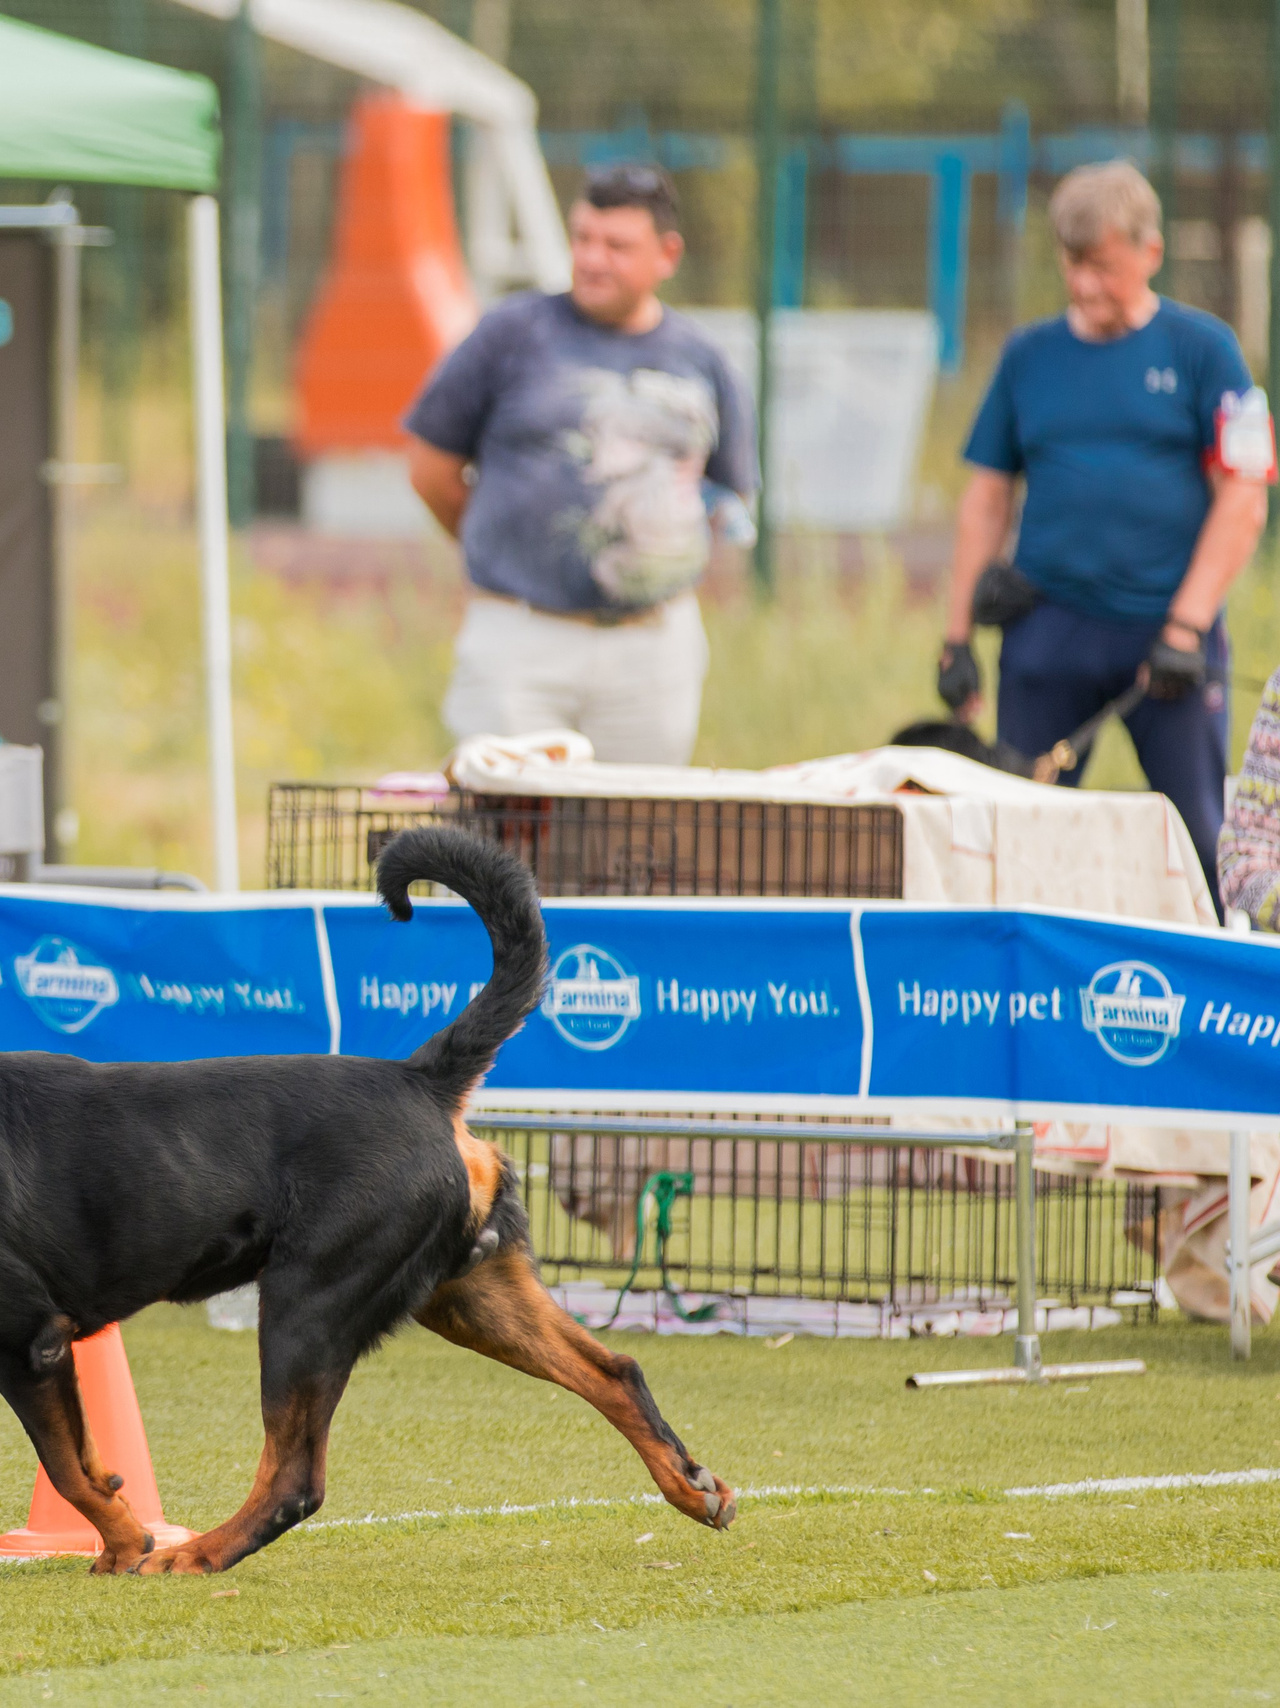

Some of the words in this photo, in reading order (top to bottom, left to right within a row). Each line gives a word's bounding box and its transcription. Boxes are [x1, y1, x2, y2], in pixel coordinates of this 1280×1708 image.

[359, 975, 458, 1018] Happy
[656, 978, 758, 1023] Happy
[767, 980, 840, 1016] You.
[897, 980, 1001, 1026] Happy
[1008, 985, 1063, 1027] pet
